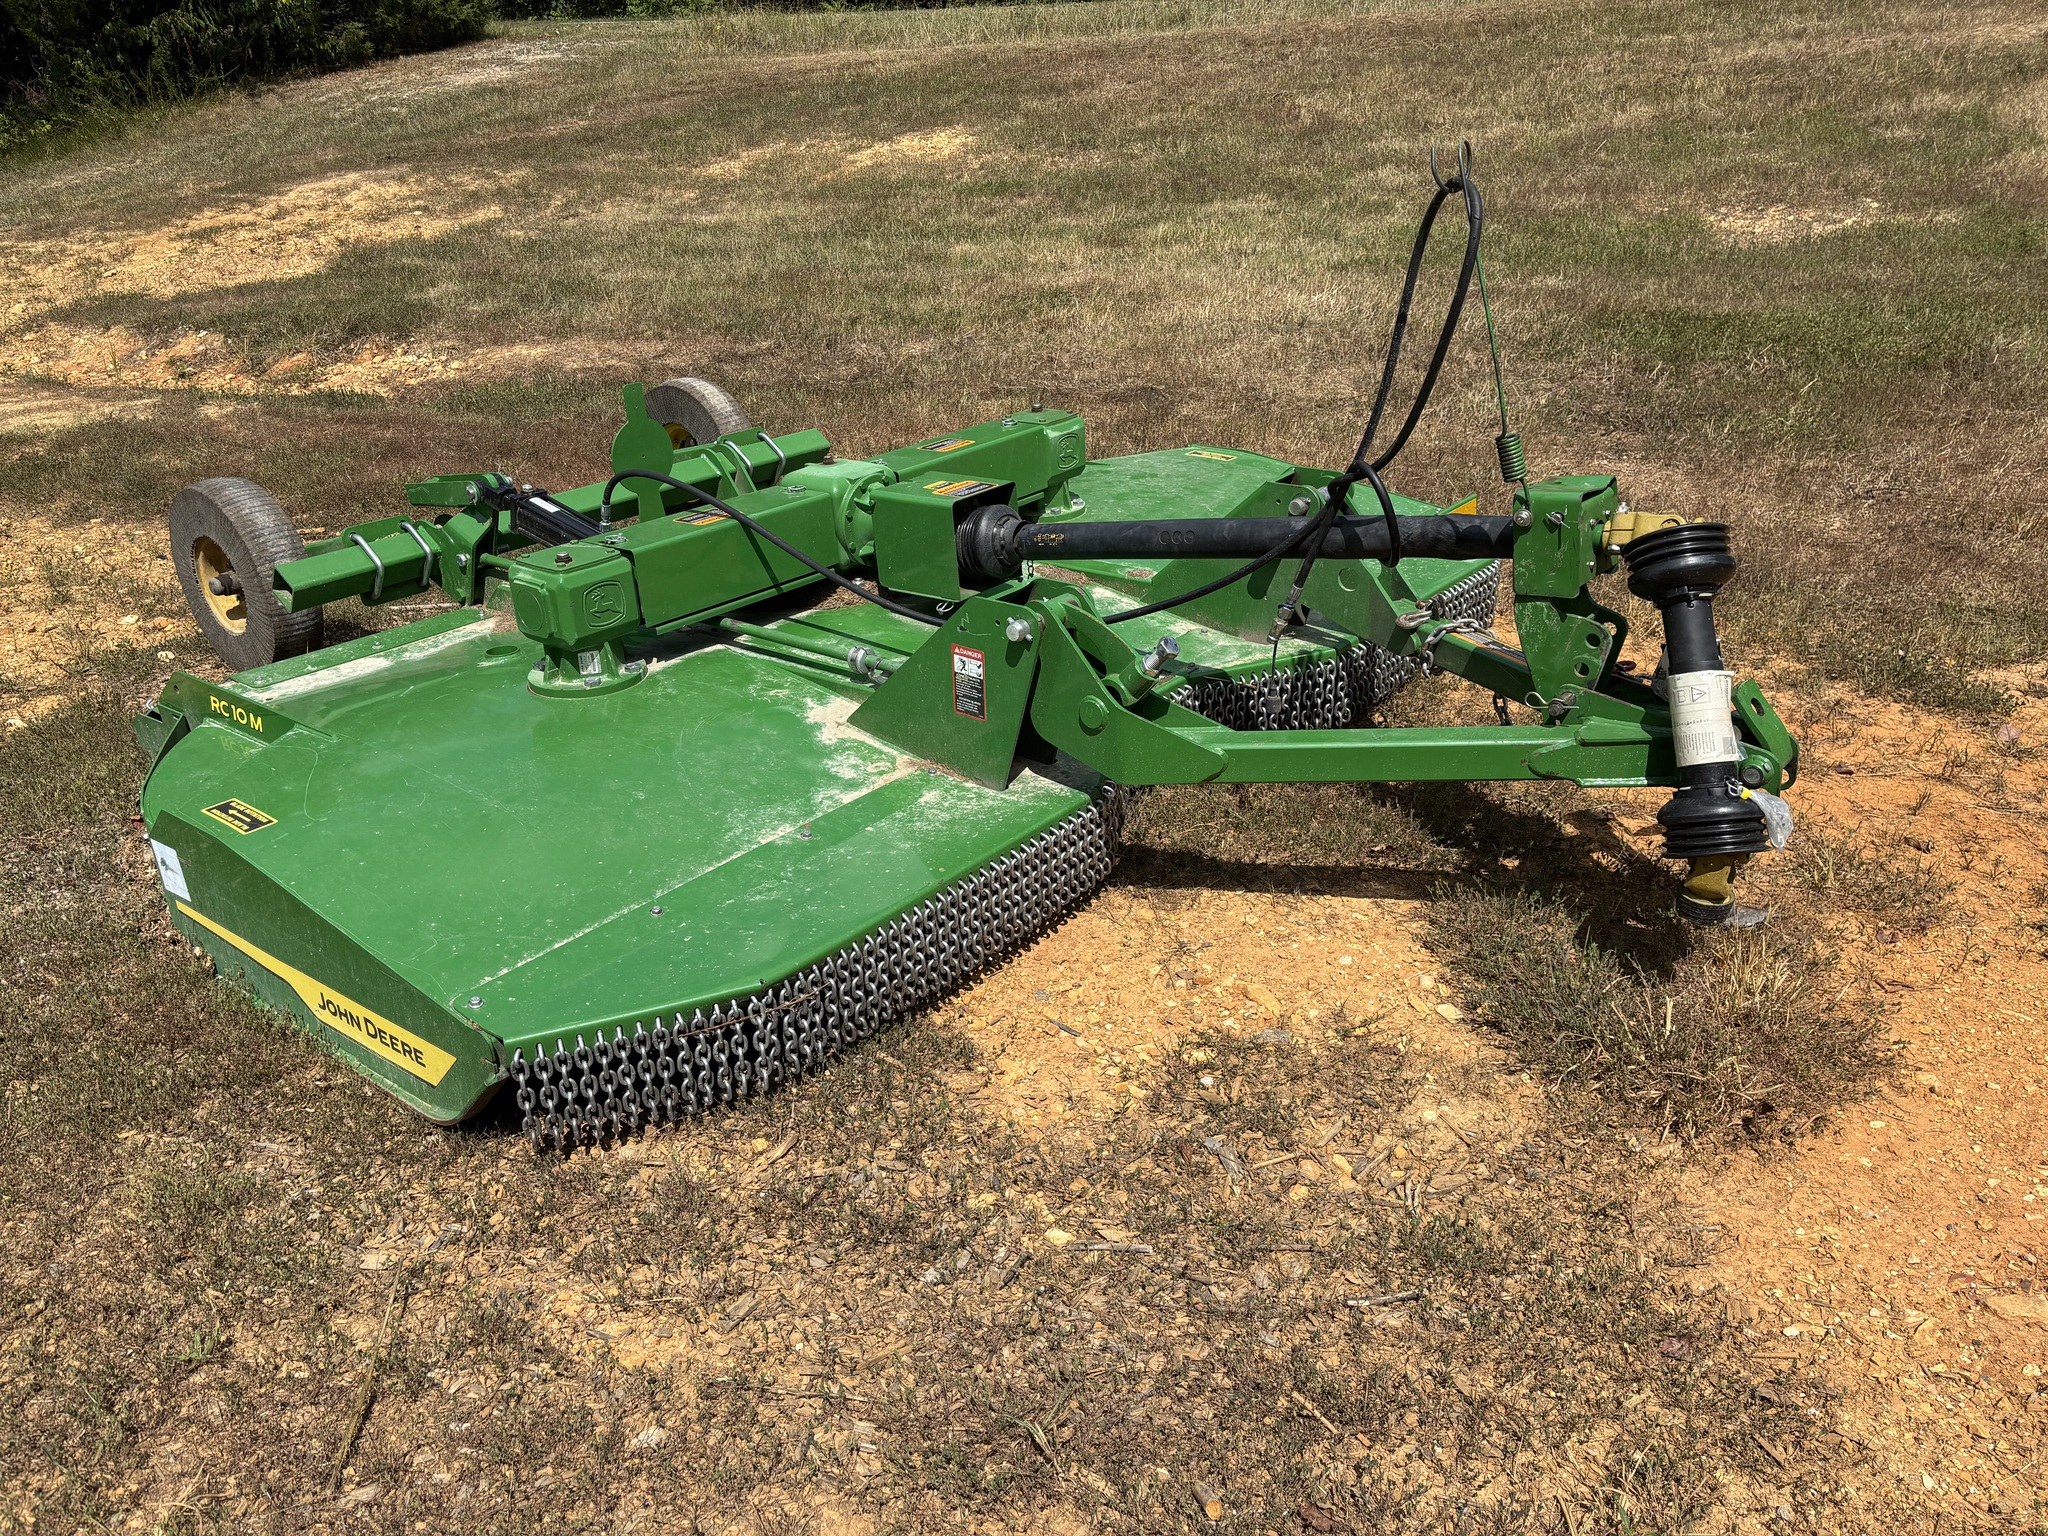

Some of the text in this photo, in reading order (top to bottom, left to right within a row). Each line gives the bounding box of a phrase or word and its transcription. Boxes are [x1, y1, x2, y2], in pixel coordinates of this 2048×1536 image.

[959, 648, 982, 659] DANGER
[210, 695, 263, 733] RC 10 M
[318, 992, 426, 1068] JOHN DEERE
